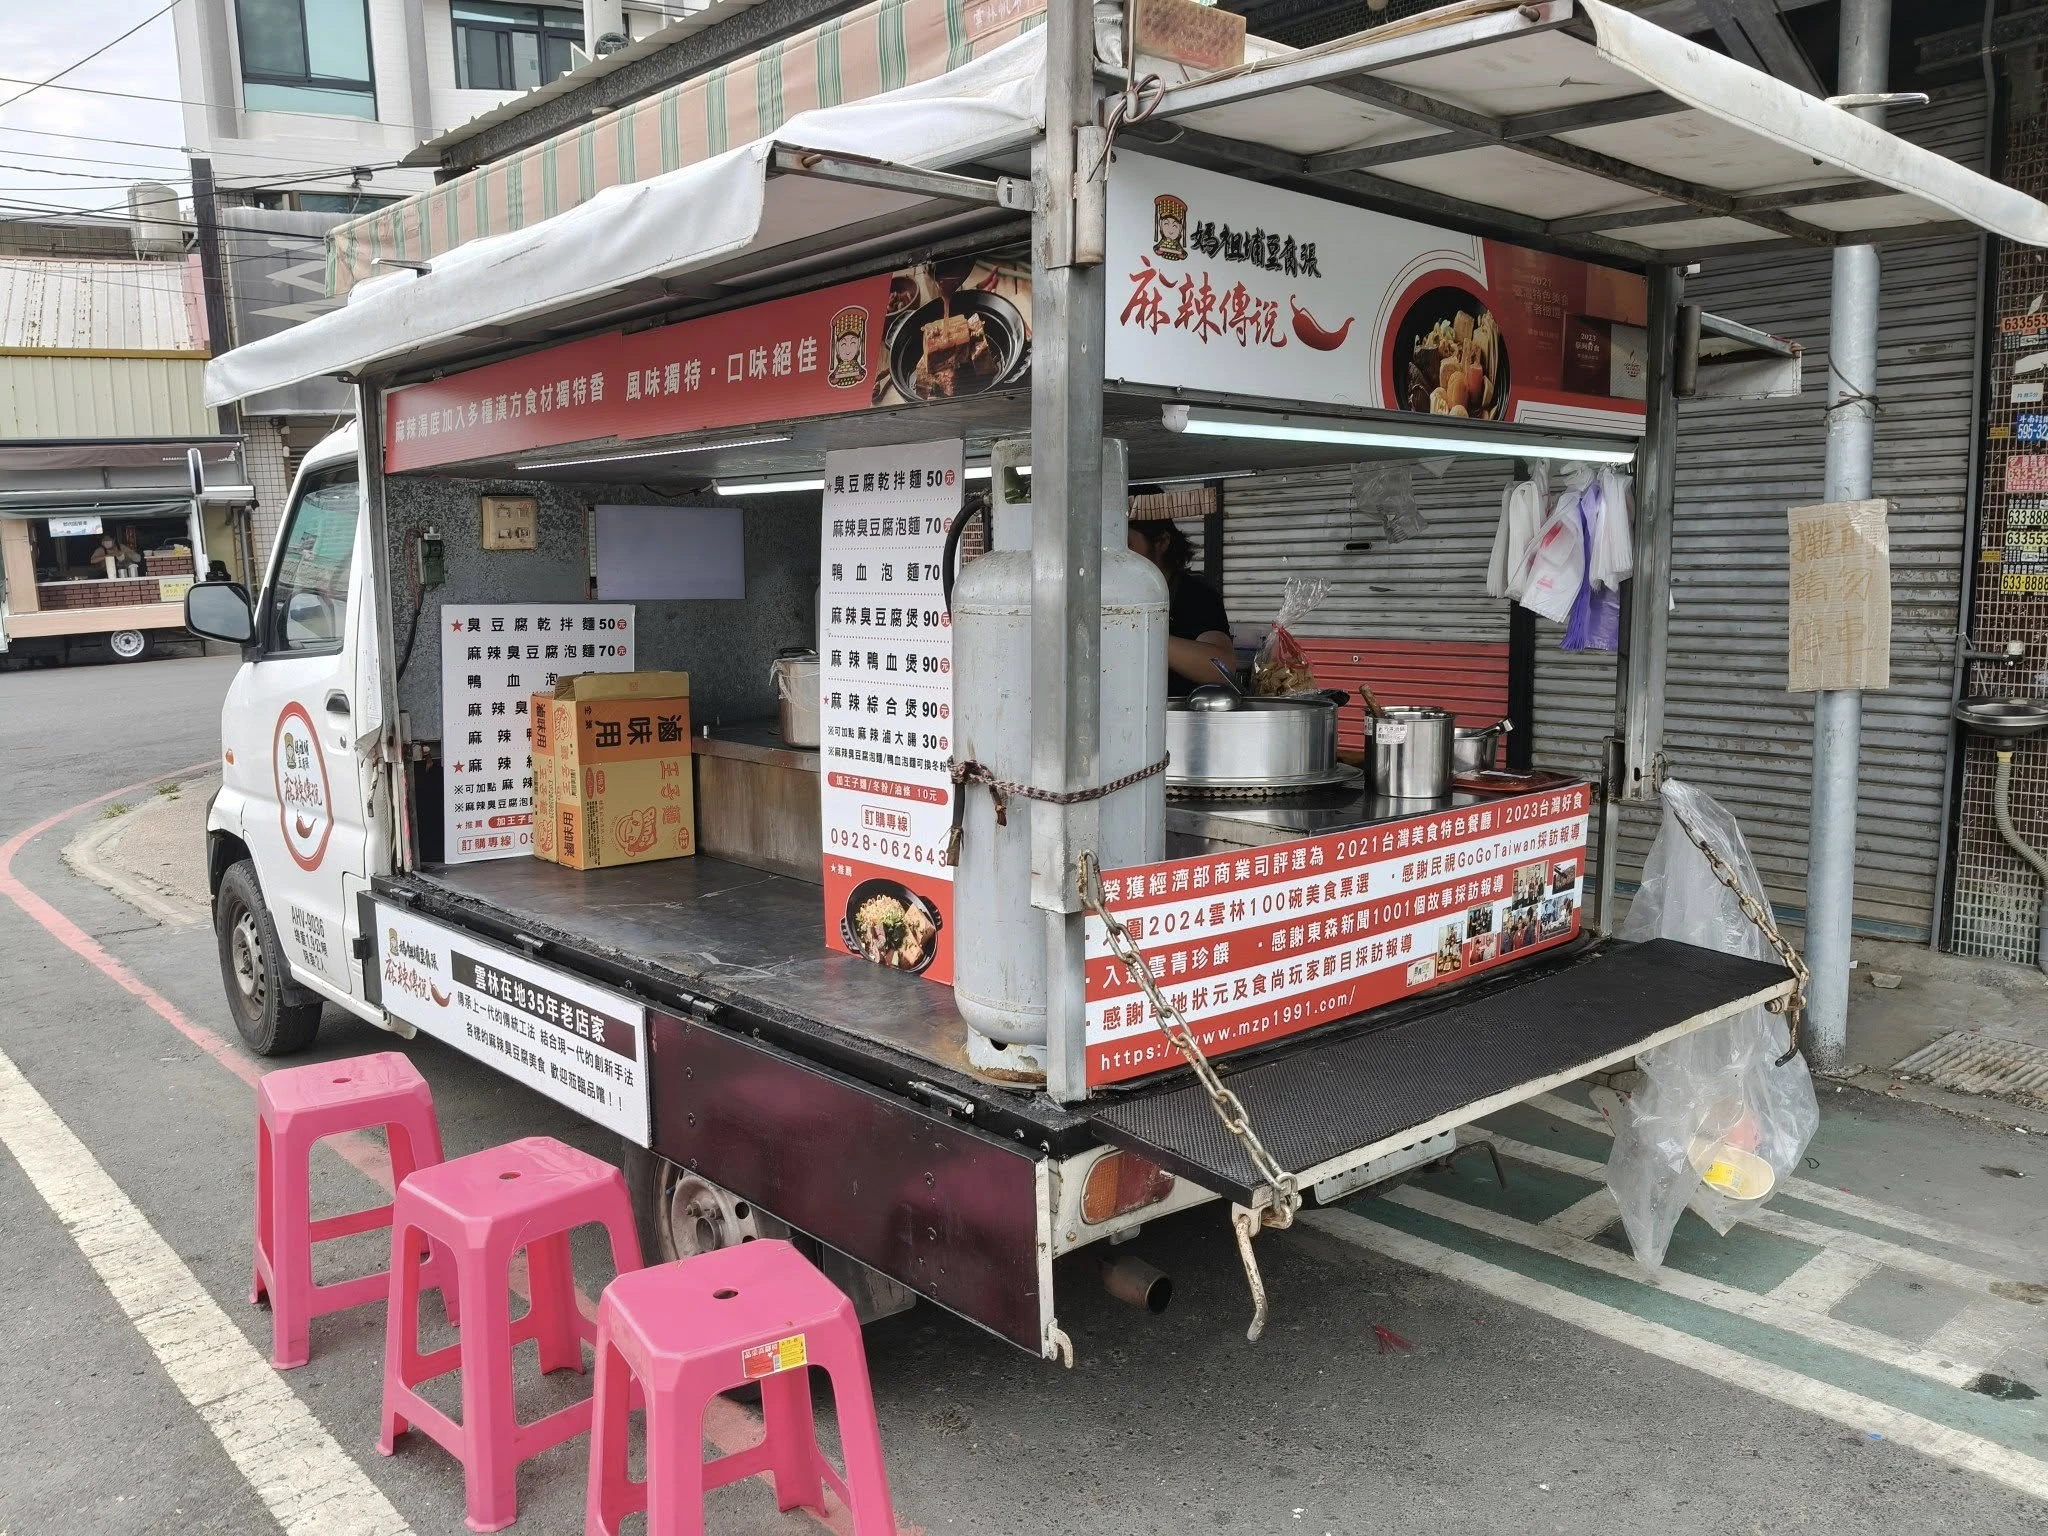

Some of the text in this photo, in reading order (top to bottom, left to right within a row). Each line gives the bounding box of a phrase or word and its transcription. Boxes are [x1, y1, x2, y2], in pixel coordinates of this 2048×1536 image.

[394, 371, 605, 443] 麻辣湯底加入多種漢方食材獨特香
[833, 470, 922, 494] 臭豆腐乾拌麵
[833, 516, 920, 538] 麻辣臭豆腐泡麵
[832, 562, 920, 582] 鴨血泡麵
[467, 616, 596, 633] 臭豆腐乾拌麵
[831, 606, 919, 628] 麻辣臭豆腐煲
[467, 644, 596, 661] 麻辣臭豆腐泡麵
[831, 649, 918, 674] 麻辣鴨血煲
[831, 691, 918, 719] 麻辣綜合煲
[864, 808, 909, 832] 訂購專線
[461, 835, 512, 851] 訂購專線
[831, 828, 947, 868] 0928-062643
[1402, 823, 1581, 884] 感謝民視GoGoTaiwan採訪報導
[1102, 844, 1325, 902] 榮獲經濟部商業司評選為
[1270, 874, 1504, 952] 感謝東森新聞1001個故事採訪報導
[474, 964, 606, 1044] 雲林在地35年老店家
